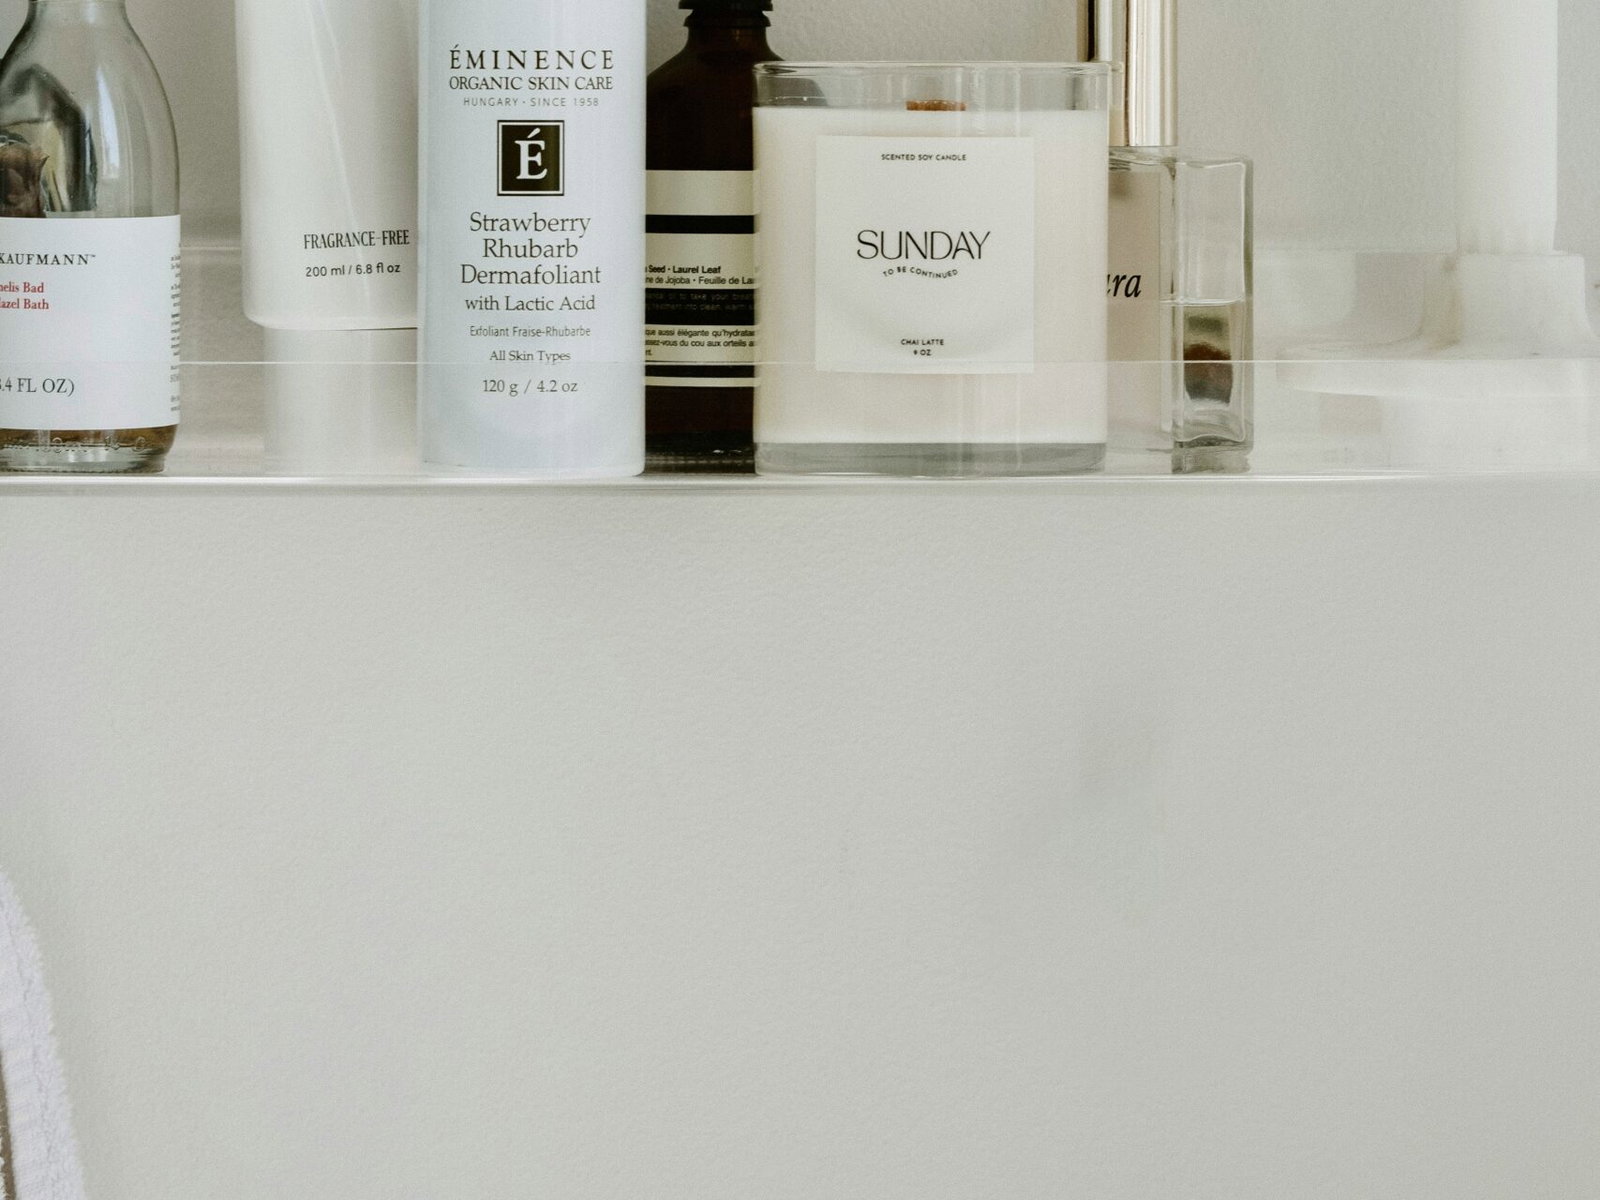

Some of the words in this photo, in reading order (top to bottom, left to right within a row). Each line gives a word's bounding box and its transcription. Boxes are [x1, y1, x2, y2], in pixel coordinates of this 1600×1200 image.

[450, 44, 614, 70] ÉMINENCE
[450, 76, 523, 90] ORGANIC
[528, 76, 569, 90] SKIN
[575, 76, 613, 90] CARE
[463, 97, 519, 107] HUNGARY
[530, 97, 567, 107] SINCE
[573, 97, 599, 107] 1958
[514, 127, 548, 180] É
[470, 211, 591, 238] Strawberry
[303, 229, 411, 249] FRAGRANCE-FREE
[857, 229, 991, 260] SUNDAY
[482, 238, 578, 258] Rhubarb
[305, 266, 328, 277] 200
[331, 265, 345, 275] ml
[355, 264, 373, 274] 6.8
[376, 262, 384, 273] fl
[386, 265, 401, 273] oz
[461, 264, 601, 284] Dermafoliant
[648, 265, 666, 274] Seed
[672, 265, 700, 274] Laurel
[701, 265, 722, 274] Leaf
[883, 268, 894, 277] TO
[909, 266, 958, 279] CONTINUED
[23, 282, 44, 293] Bad
[665, 275, 690, 286] Jojoba
[698, 275, 726, 285] Feuille
[728, 276, 740, 285] de
[24, 299, 49, 310] Bath
[465, 296, 499, 311] with
[505, 296, 554, 311] Lactic
[559, 296, 596, 311] Acid
[513, 326, 591, 337] Fraise-Rhubarbe
[490, 351, 506, 360] All
[509, 351, 533, 360] Skin
[538, 351, 571, 364] Types
[18, 378, 36, 393] FL
[42, 378, 75, 396] OZ)
[483, 380, 505, 392] 120
[509, 382, 519, 396] g
[537, 380, 557, 392] 4.2
[561, 383, 578, 392] oz
